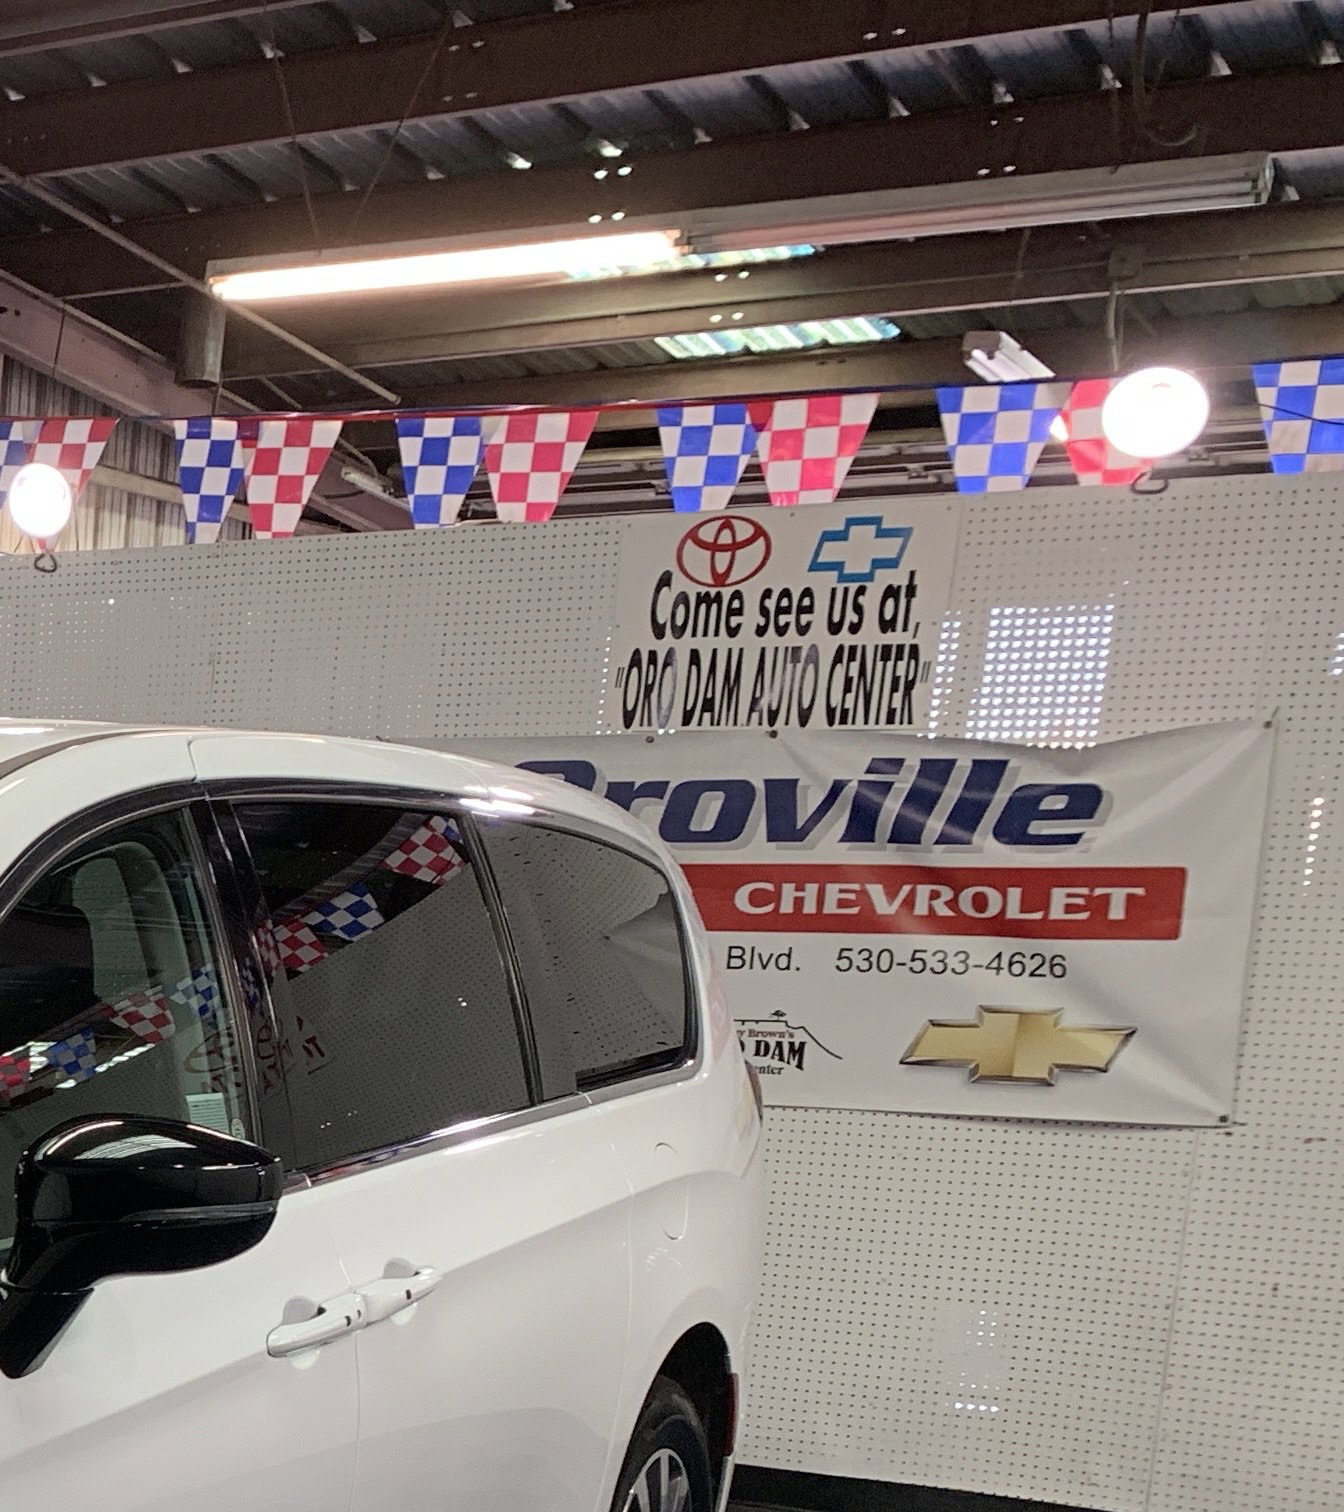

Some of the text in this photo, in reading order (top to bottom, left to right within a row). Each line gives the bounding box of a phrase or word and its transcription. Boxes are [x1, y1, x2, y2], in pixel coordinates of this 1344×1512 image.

[650, 569, 921, 640] Come see us at,
[615, 643, 932, 730] "ORO DAM AUTO CENTER"
[733, 880, 1146, 921] CHEVROLET
[725, 945, 1069, 979] Blvd. 530-533-4626
[748, 1028, 795, 1039] Brown's
[753, 1039, 807, 1072] DAM
